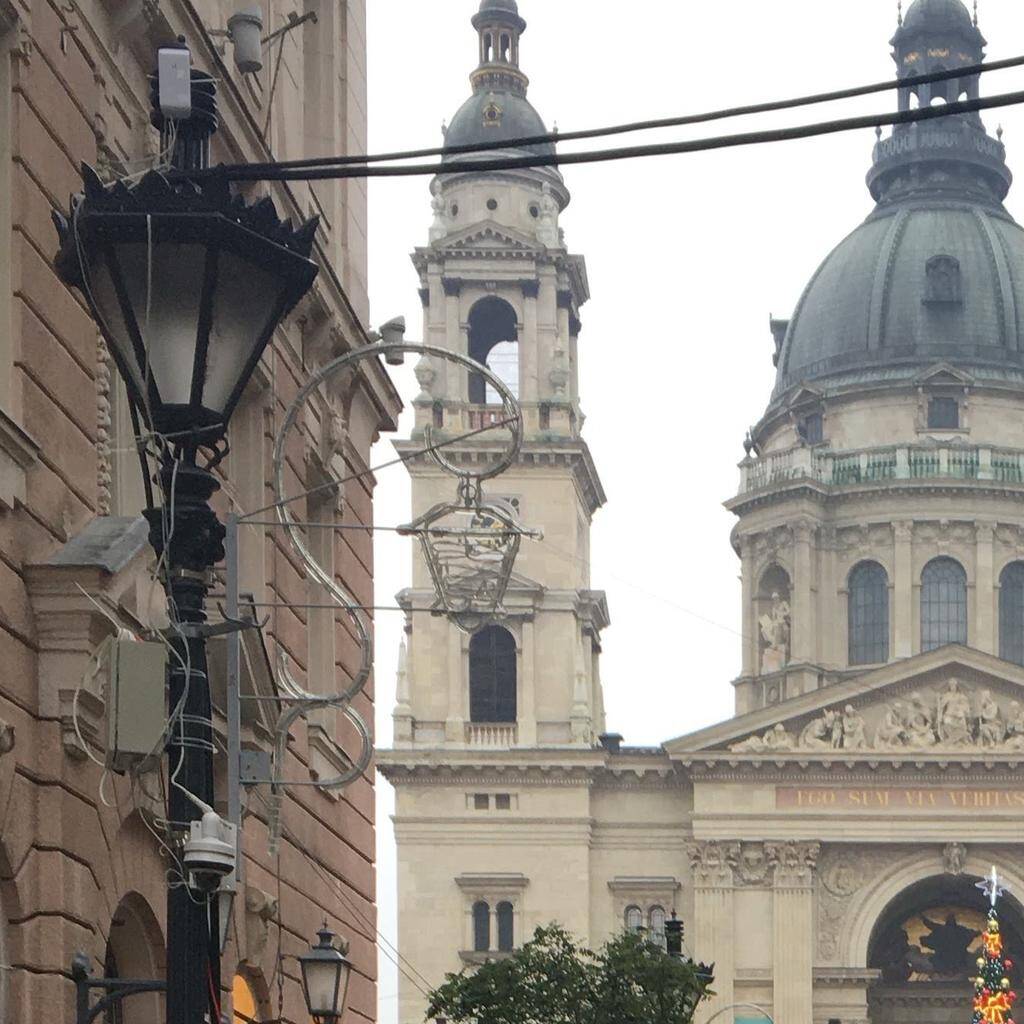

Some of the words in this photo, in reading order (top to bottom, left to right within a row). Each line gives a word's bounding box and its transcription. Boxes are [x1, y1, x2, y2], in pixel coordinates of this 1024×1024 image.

[797, 790, 836, 806] EGO
[849, 790, 889, 806] SUM
[905, 791, 936, 806] VIA
